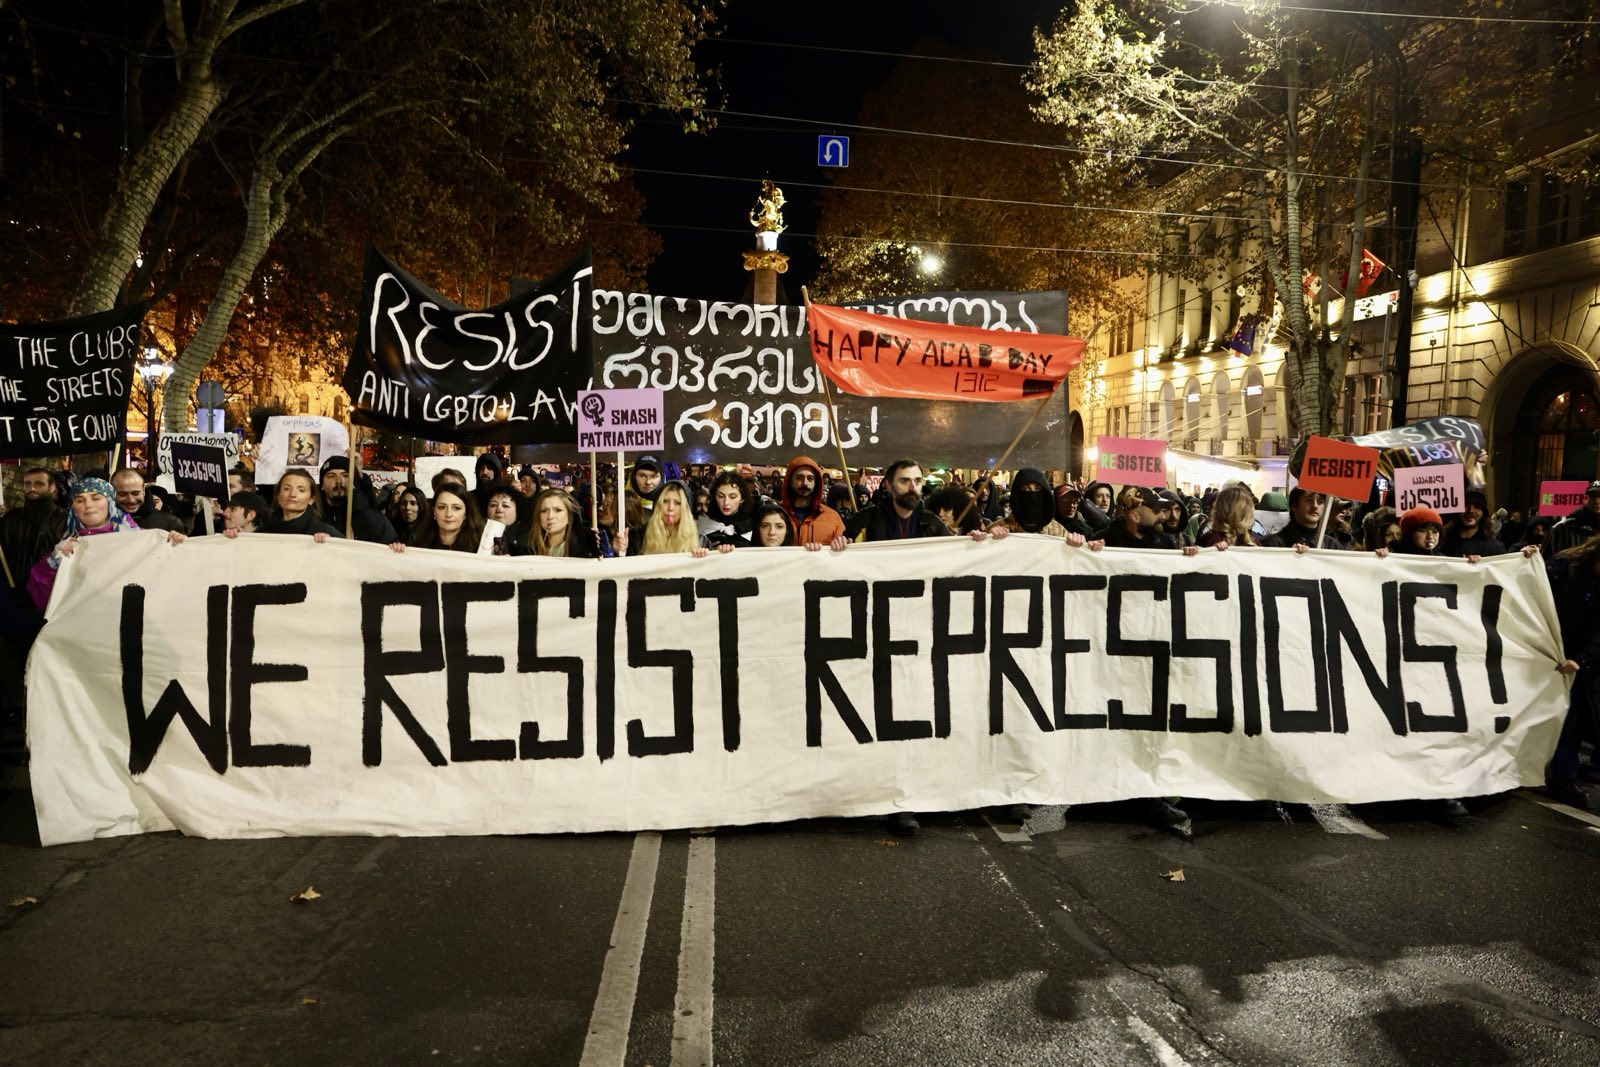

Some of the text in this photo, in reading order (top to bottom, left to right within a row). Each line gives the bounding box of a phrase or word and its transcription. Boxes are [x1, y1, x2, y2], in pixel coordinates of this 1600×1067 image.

[370, 266, 592, 371] RESIST
[14, 336, 59, 369] THE
[814, 329, 911, 366] HAPPY
[921, 339, 993, 369] ACAB
[46, 368, 124, 403] STREETS
[358, 370, 409, 419] ANTI
[954, 372, 999, 393] 1312
[26, 417, 62, 447] FOR
[611, 408, 657, 425] SMASH
[580, 430, 662, 447] PATRIARCHY
[1101, 452, 1162, 473] RESISTER
[1308, 458, 1371, 479] RESIST!
[120, 572, 1510, 776] WE RESIST REPRESSIONS!
